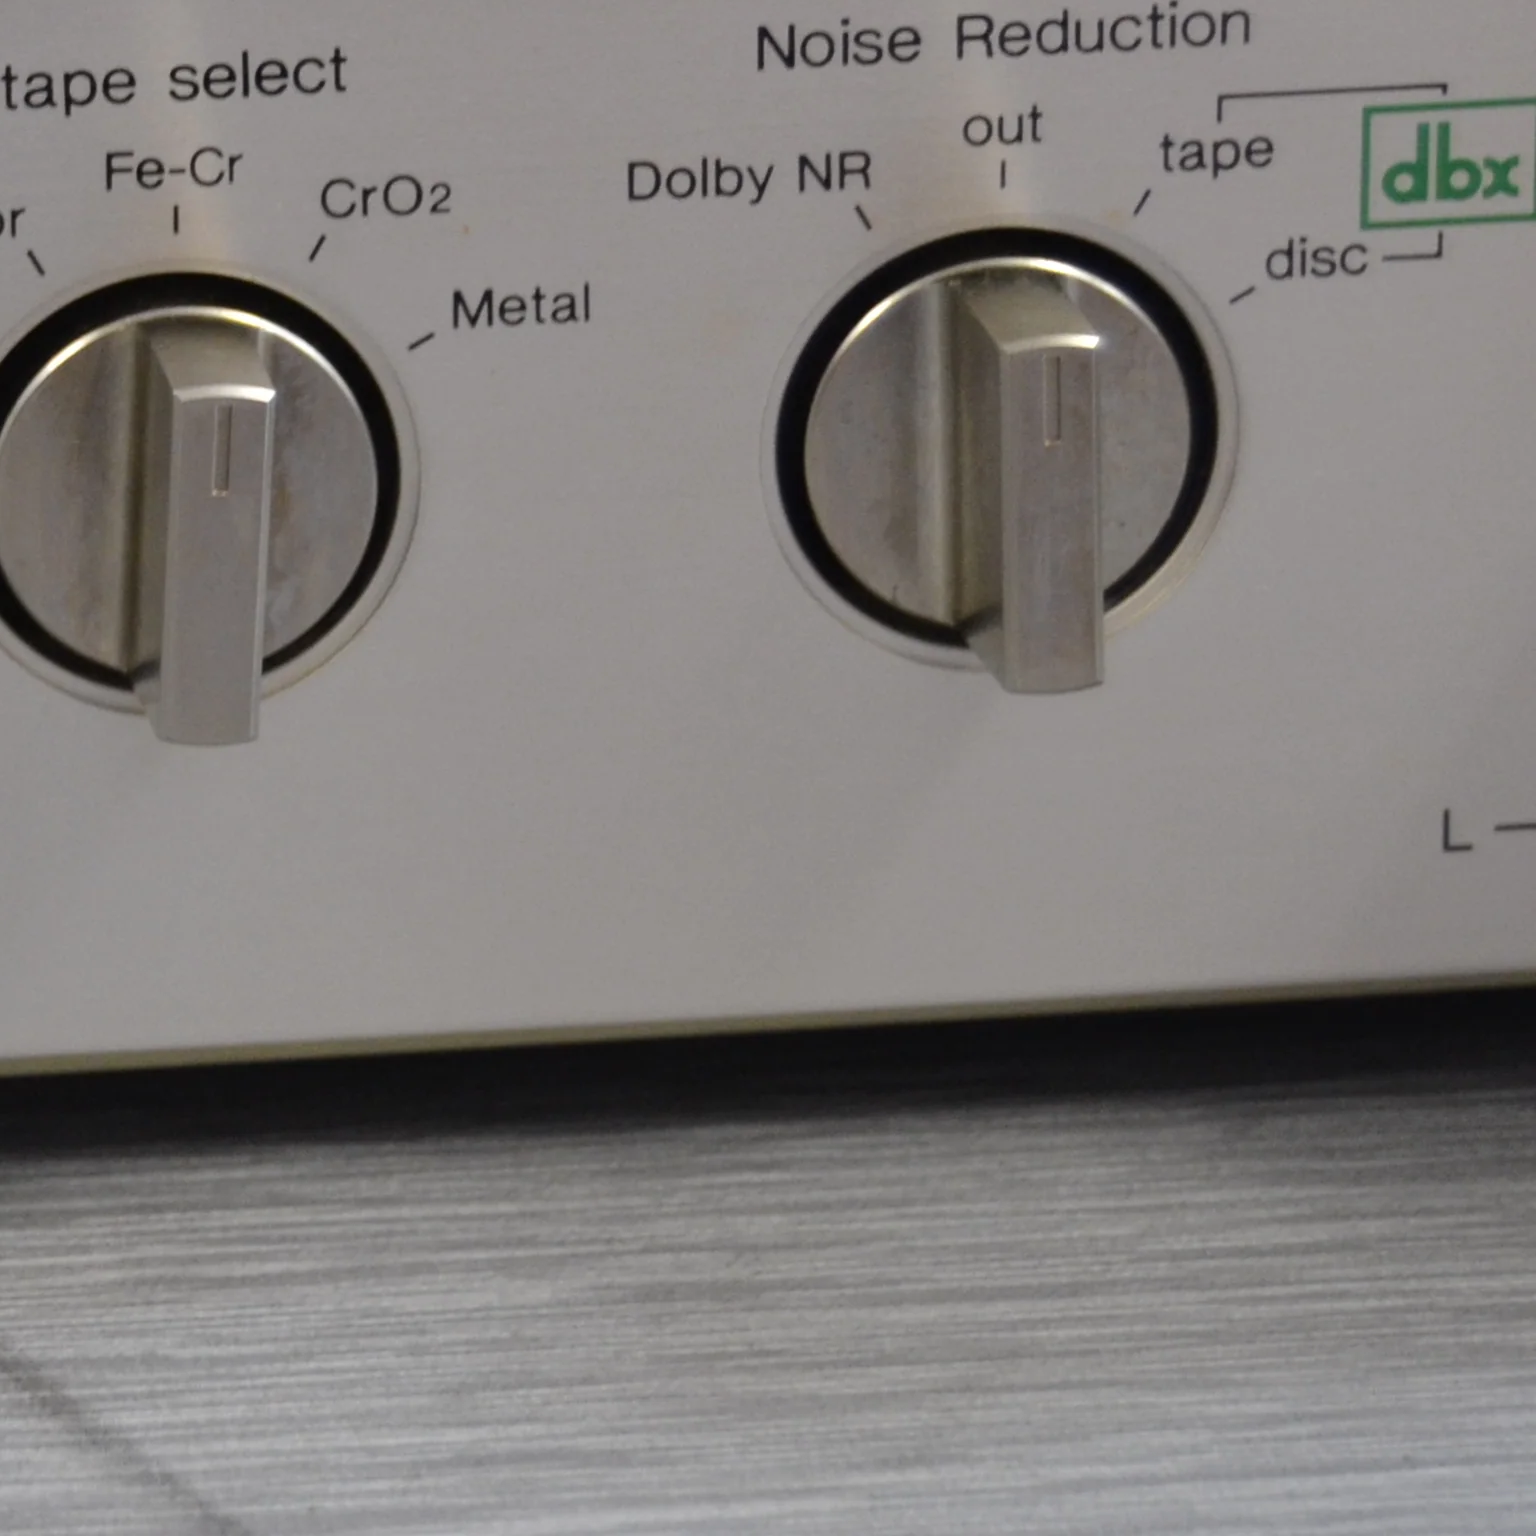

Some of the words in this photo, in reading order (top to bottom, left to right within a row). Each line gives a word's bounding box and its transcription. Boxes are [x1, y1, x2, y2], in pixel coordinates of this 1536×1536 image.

[756, 17, 923, 72] Noise
[0, 64, 138, 118] tape
[168, 46, 348, 103] select
[961, 103, 1044, 148] out
[104, 145, 244, 193] Fe-Cr
[626, 155, 775, 206] Dolby
[797, 149, 873, 194] NR
[1159, 132, 1276, 180] tape
[1381, 120, 1521, 206] dbx
[1264, 235, 1369, 282] disc
[451, 282, 591, 330] Metal
[1441, 807, 1475, 854] L
